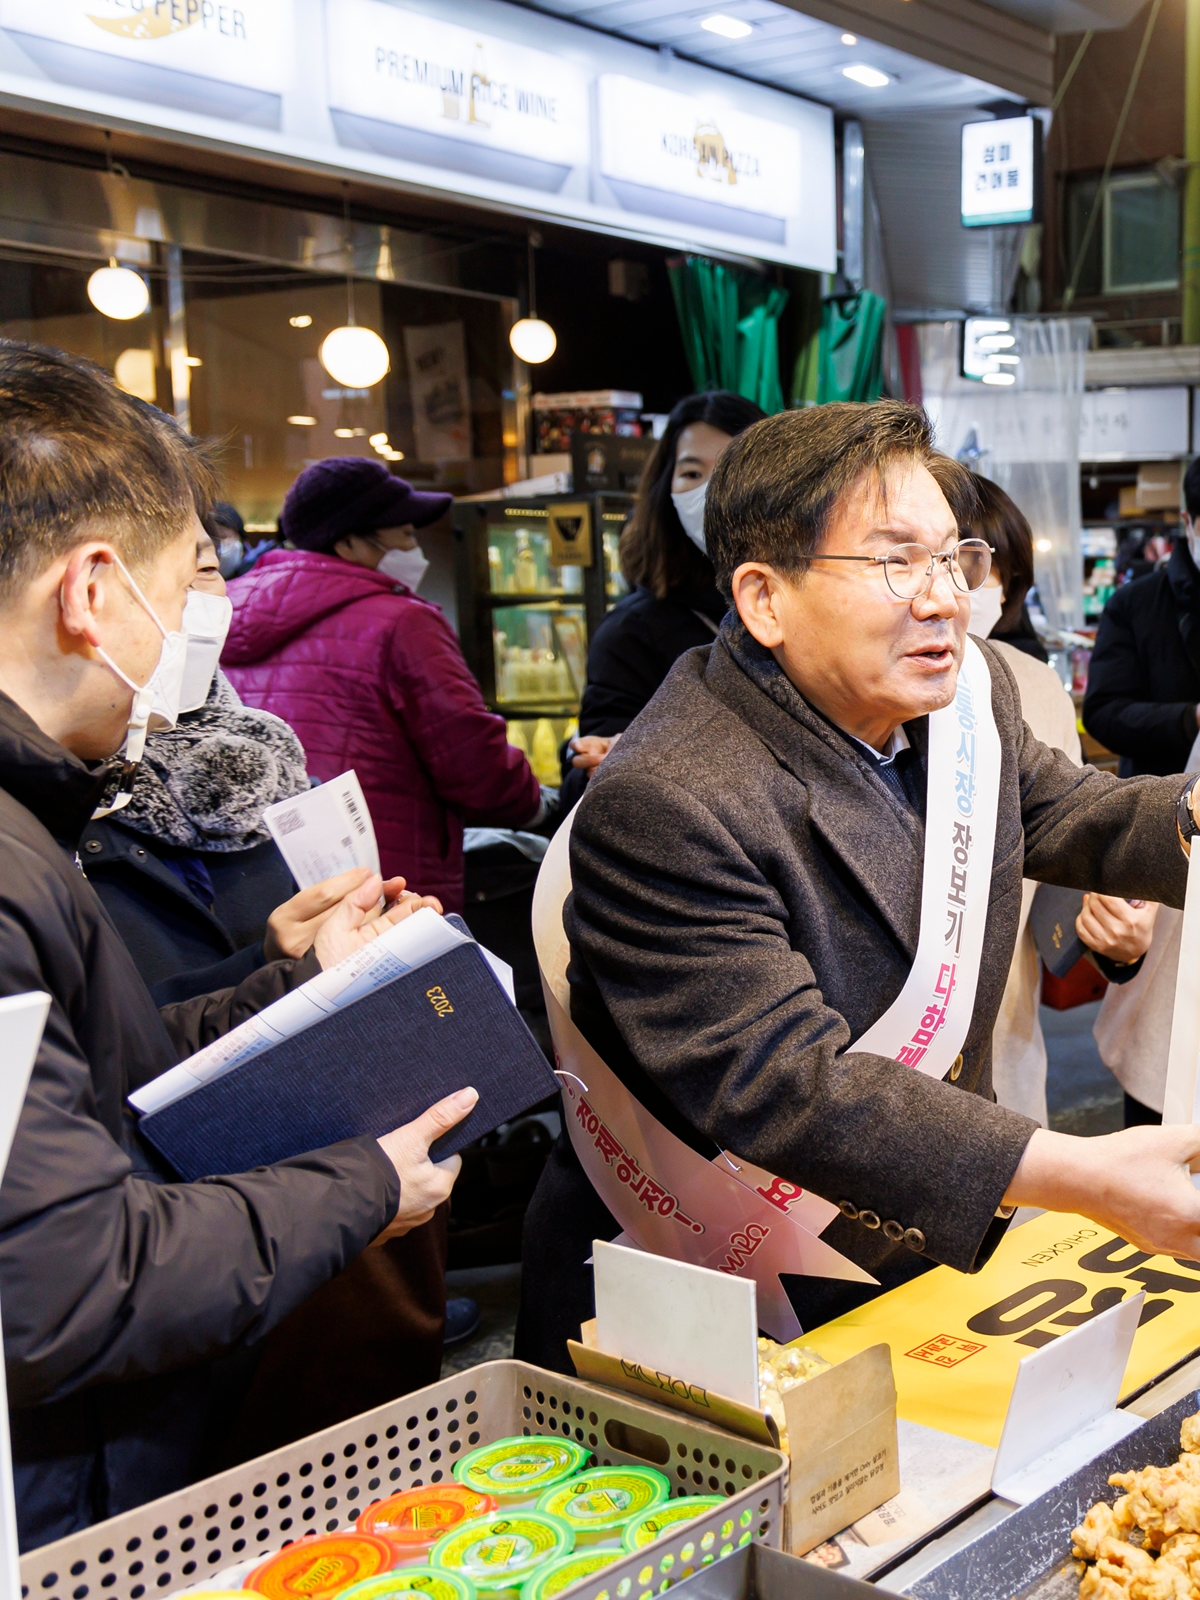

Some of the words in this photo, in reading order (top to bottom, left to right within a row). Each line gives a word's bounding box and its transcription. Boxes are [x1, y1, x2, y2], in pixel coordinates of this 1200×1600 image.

[153, 0, 247, 39] PEPPER
[375, 47, 464, 96] PREMIUM
[470, 73, 509, 111] RICE
[514, 87, 558, 124] WINE
[944, 821, 973, 956] 장보기
[425, 985, 456, 1018] 2023
[574, 1096, 705, 1235] 경제안정!
[1020, 1229, 1099, 1268] CHICKEN
[859, 1460, 872, 1472] Only
